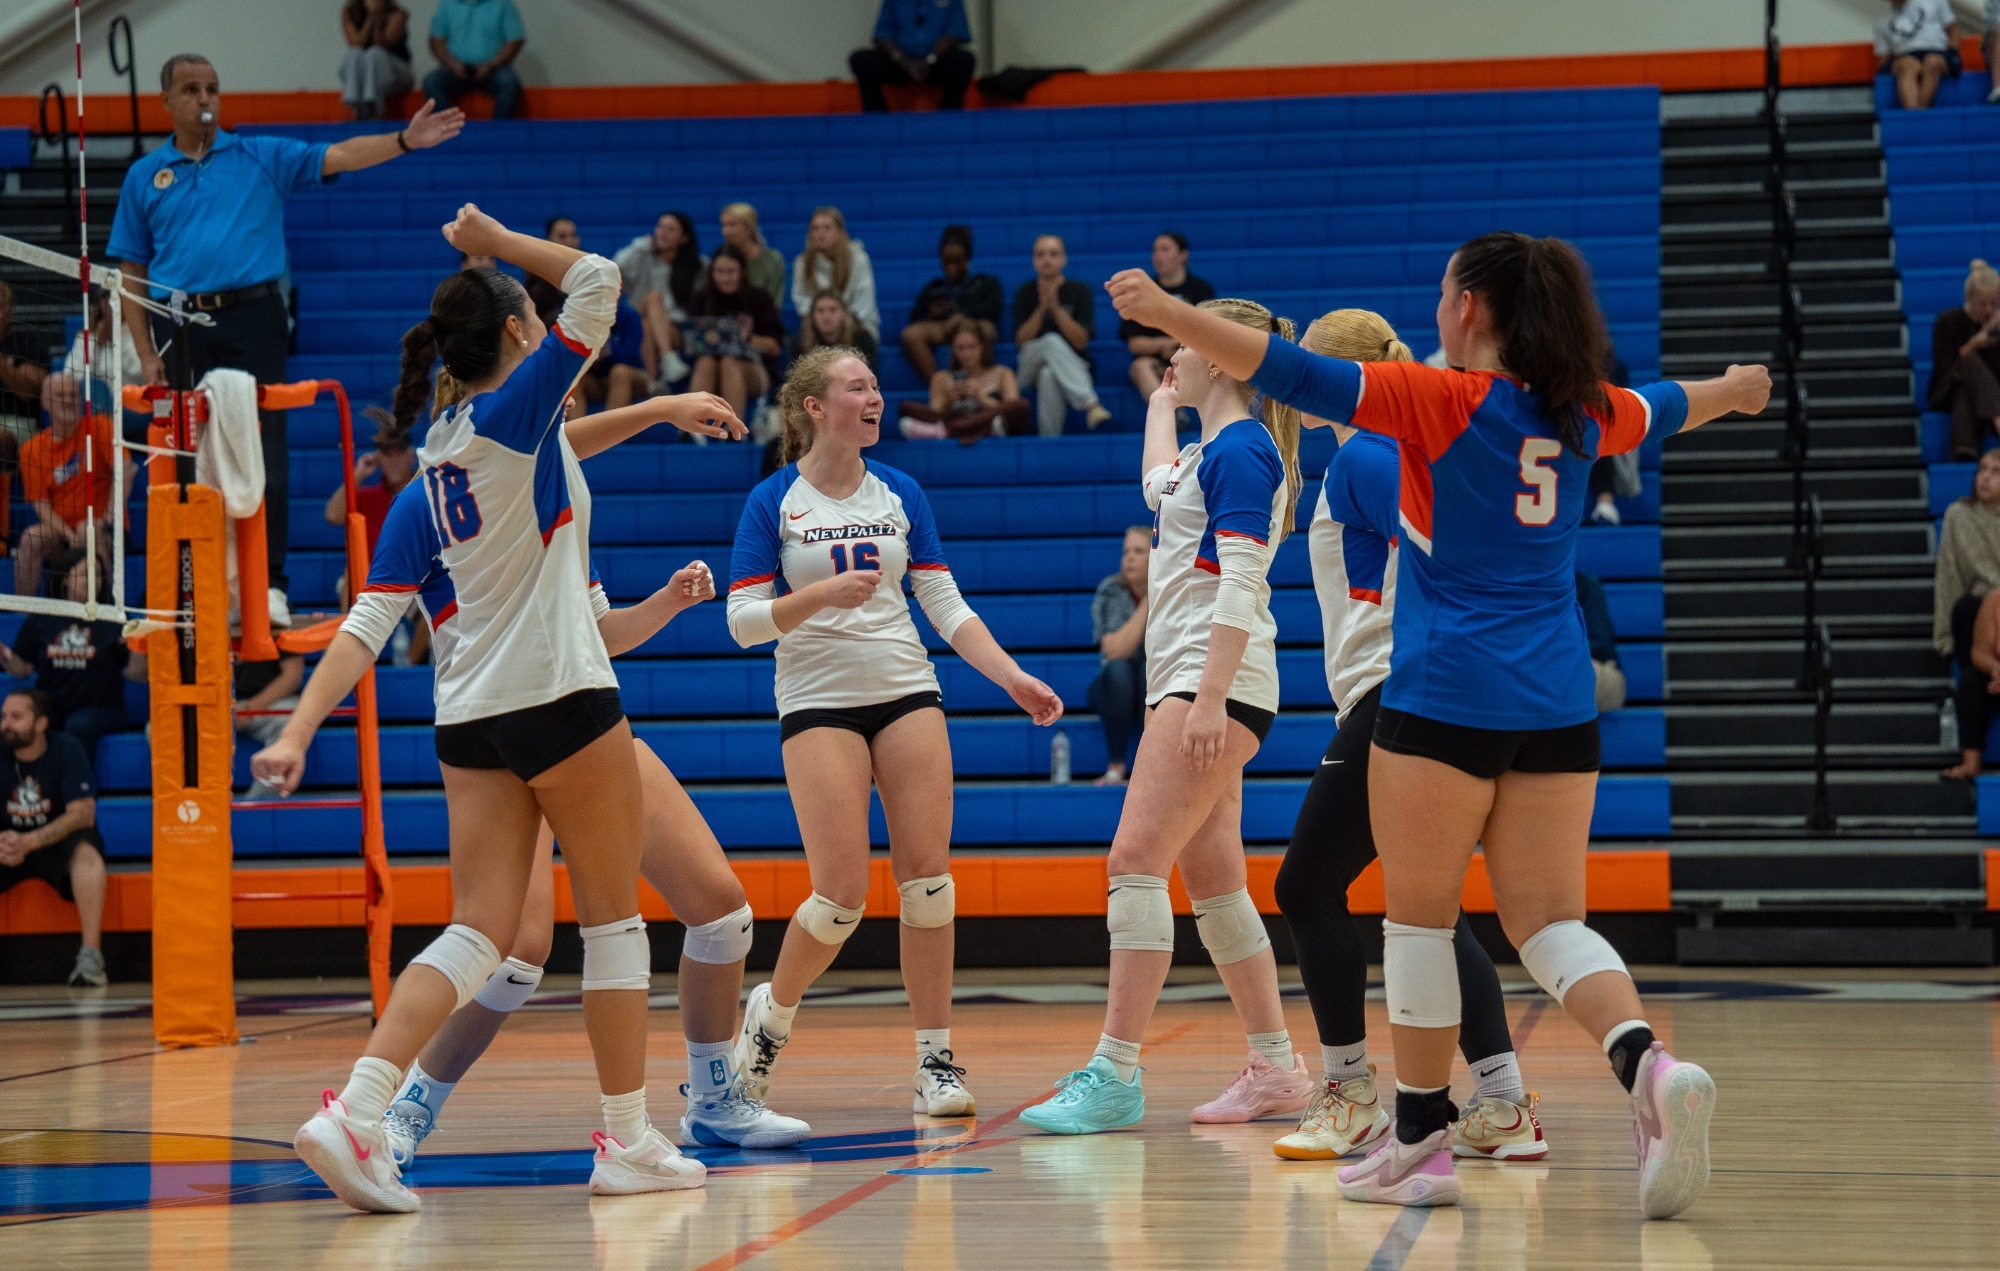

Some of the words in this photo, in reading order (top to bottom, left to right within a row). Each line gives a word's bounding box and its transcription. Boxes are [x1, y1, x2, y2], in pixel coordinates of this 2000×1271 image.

[426, 461, 483, 550] 18
[1514, 436, 1563, 527] 5
[803, 527, 846, 543] NEW
[846, 524, 896, 538] PALTZ
